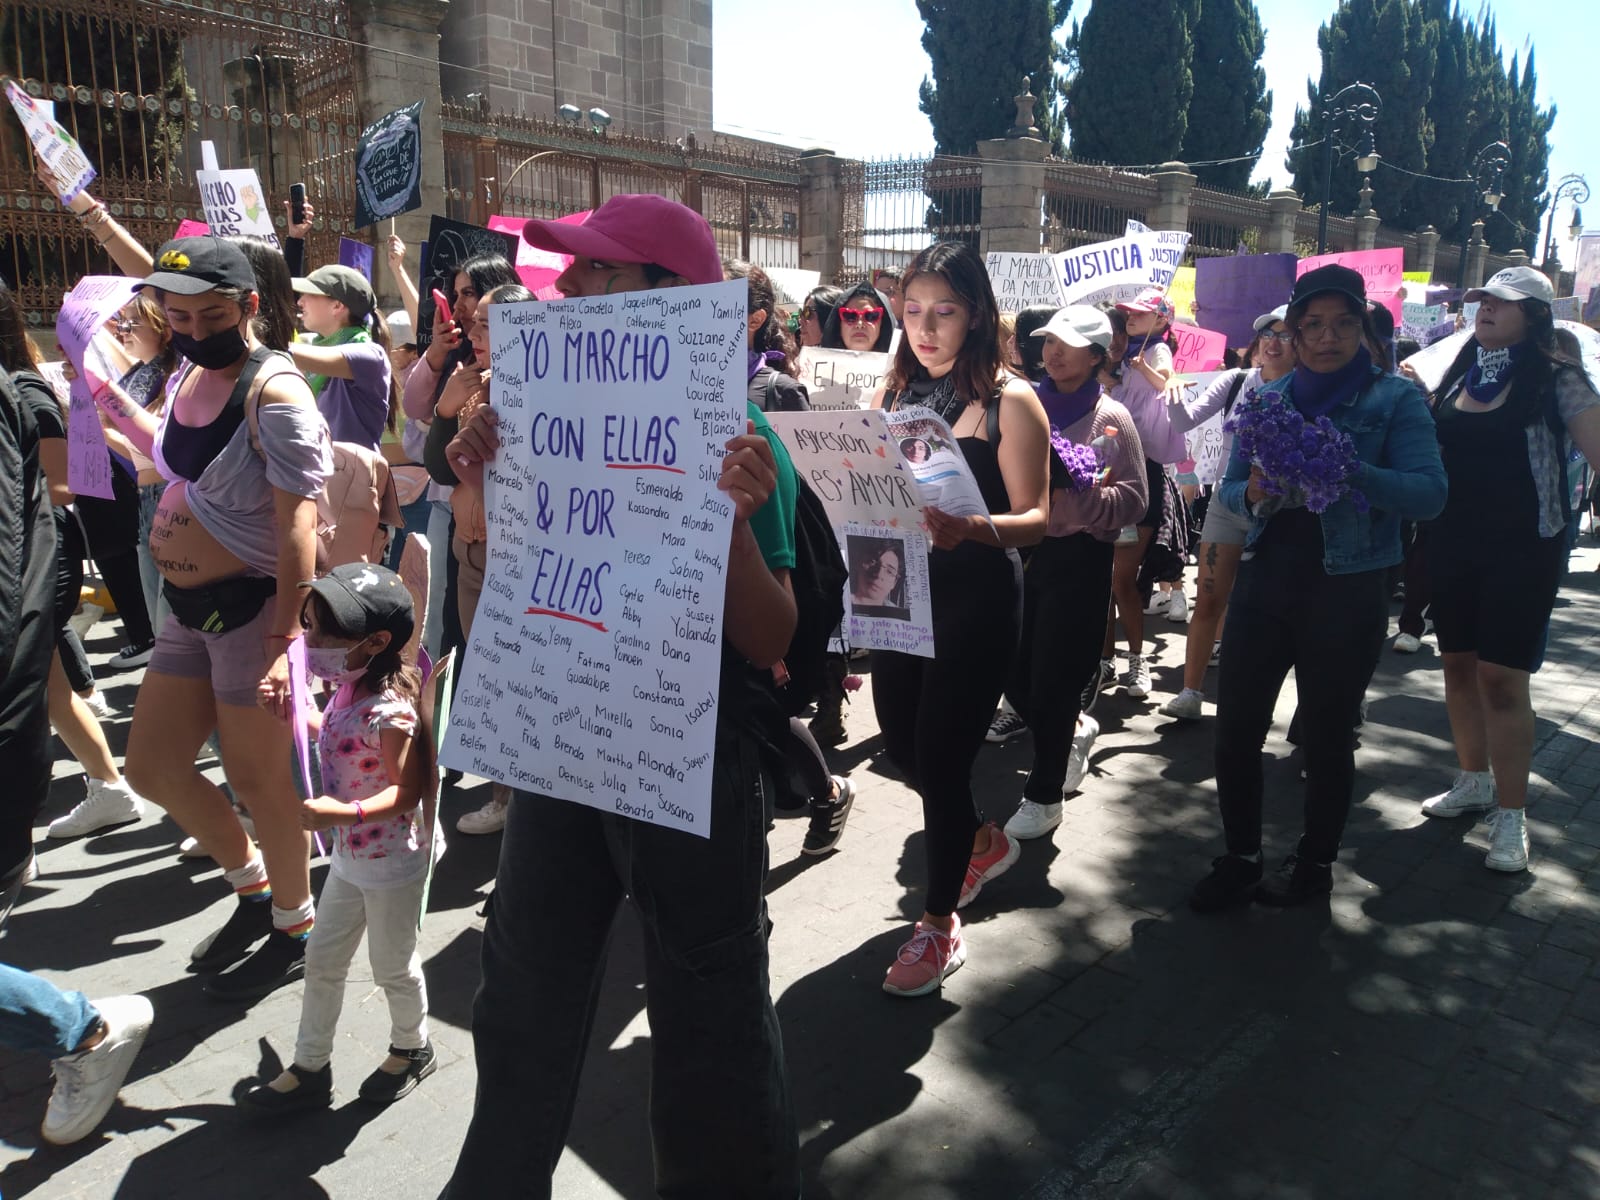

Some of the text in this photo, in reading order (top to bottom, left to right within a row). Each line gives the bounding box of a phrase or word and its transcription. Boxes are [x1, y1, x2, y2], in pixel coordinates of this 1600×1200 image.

[1063, 243, 1143, 287] JUSTICIA
[1002, 278, 1059, 297] DA MIEDO
[578, 299, 614, 315] Candela
[621, 293, 662, 313] Jaqueline
[661, 298, 701, 318] Dayana
[711, 299, 745, 320] Yamilet
[501, 309, 667, 330] Madeleine Alexa Catherine
[491, 337, 520, 363] Patricia
[520, 328, 670, 385] YO MARCHO
[689, 350, 717, 367] Gaia
[690, 368, 725, 390] Nicole
[814, 361, 884, 394] El peor
[502, 390, 523, 408] Dalia
[686, 386, 724, 403] Lourdes
[693, 407, 741, 425] Kimberly
[531, 411, 681, 466] CON ELLAS
[702, 421, 735, 437] Blanca
[793, 422, 872, 455] Agresión
[500, 435, 524, 448] Diana
[488, 469, 523, 491] Maricela
[503, 452, 537, 487] Maribel
[635, 477, 684, 502] Esmeralda
[811, 469, 842, 502] es
[501, 494, 528, 528] Sandra
[537, 481, 615, 538] & POR
[700, 492, 729, 519] Jessica
[169, 511, 192, 527] por
[488, 511, 513, 527] Astrid
[681, 514, 714, 532] Alondra
[500, 528, 524, 545] Aisha
[661, 531, 686, 546] Mara
[491, 548, 518, 564] Andrea
[624, 549, 651, 566] Teresa
[694, 548, 722, 575] Wendy
[530, 547, 612, 616] ELLAS
[669, 556, 704, 583] Sabina
[487, 573, 515, 602] Rosalba
[619, 583, 645, 604] Cyntia
[654, 578, 700, 605] Paulette
[483, 602, 514, 626] Valentina
[621, 605, 642, 629] Abby
[614, 630, 651, 652] Carolina
[670, 615, 717, 645] Yolanda
[493, 632, 522, 656] Fernanda
[662, 639, 691, 664] Dana
[531, 656, 545, 676] Luz
[577, 651, 611, 673] Fatima
[476, 672, 504, 701] Marilyn
[566, 668, 611, 693] Guadalupe
[655, 668, 681, 694] Yara
[461, 688, 491, 710] Gisselle
[533, 686, 559, 705] María
[632, 684, 685, 708] Constanza
[515, 703, 537, 729] Alma
[595, 704, 633, 730] Mirella
[684, 690, 716, 726] Isabel
[451, 713, 476, 730] Cecilia
[481, 711, 498, 735] Delia
[579, 714, 613, 740] Liliana
[650, 715, 684, 741] Sonia
[460, 733, 487, 752] Belém
[500, 742, 519, 759] Rosa
[521, 728, 541, 751] Frida
[554, 734, 585, 761] Brenda
[473, 757, 505, 781] Mariana
[596, 748, 633, 770] Martha
[638, 750, 685, 783] Alondra
[509, 761, 553, 791] Esperanza
[558, 765, 595, 793] Denisse
[600, 771, 627, 794] Julia
[615, 797, 654, 820] Renata
[657, 792, 695, 823] Susana
